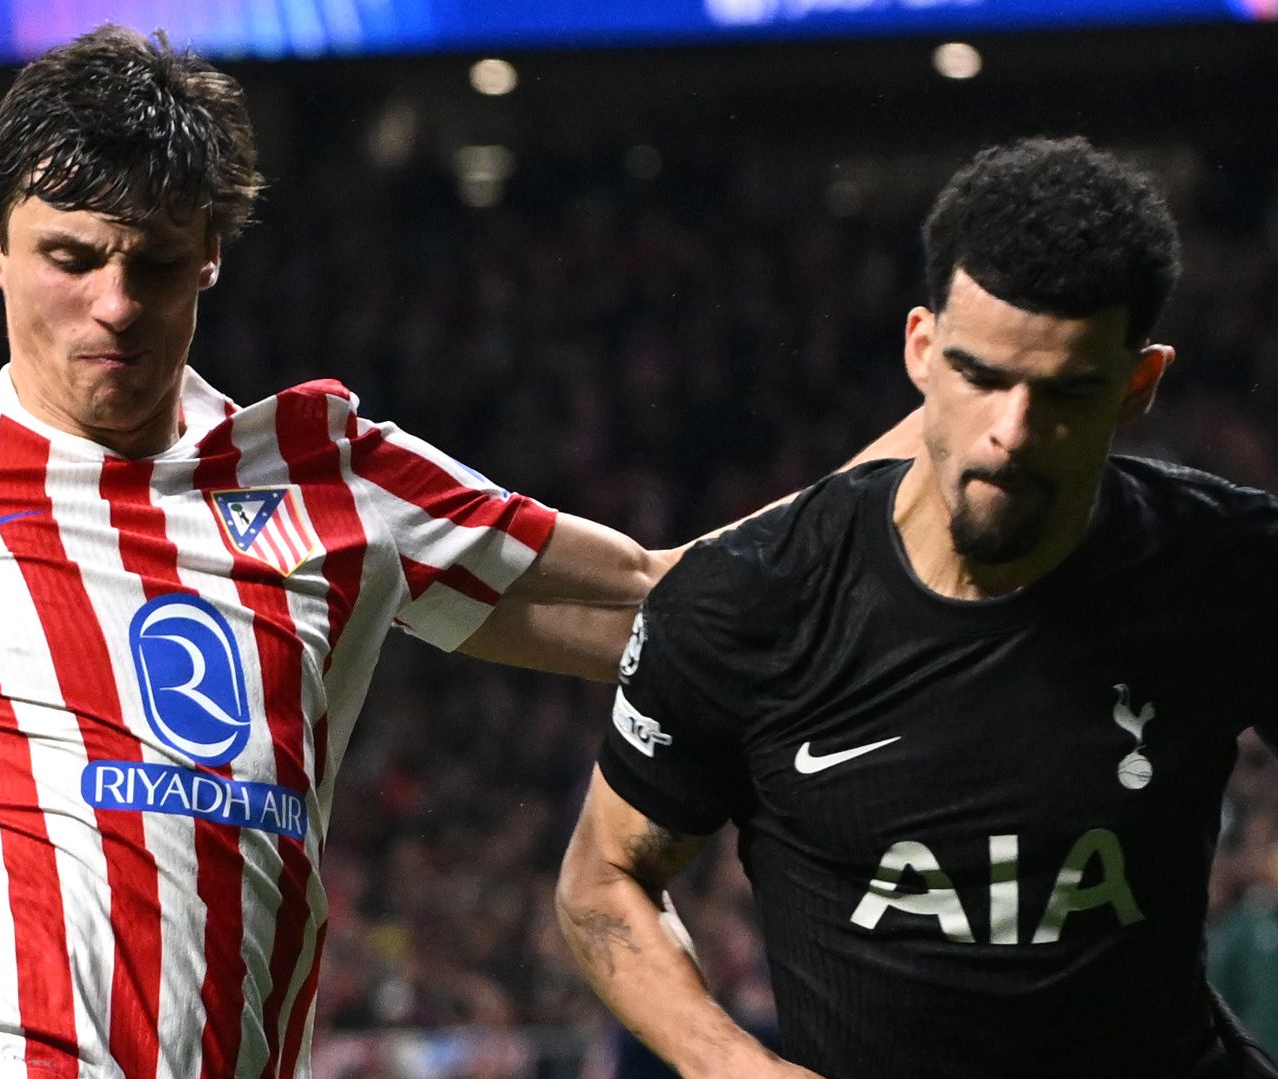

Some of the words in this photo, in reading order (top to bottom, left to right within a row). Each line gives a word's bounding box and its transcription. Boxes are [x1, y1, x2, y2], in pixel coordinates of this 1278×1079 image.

[95, 765, 251, 821] RIYADH
[259, 793, 304, 836] AIR
[849, 828, 1146, 945] AIA
